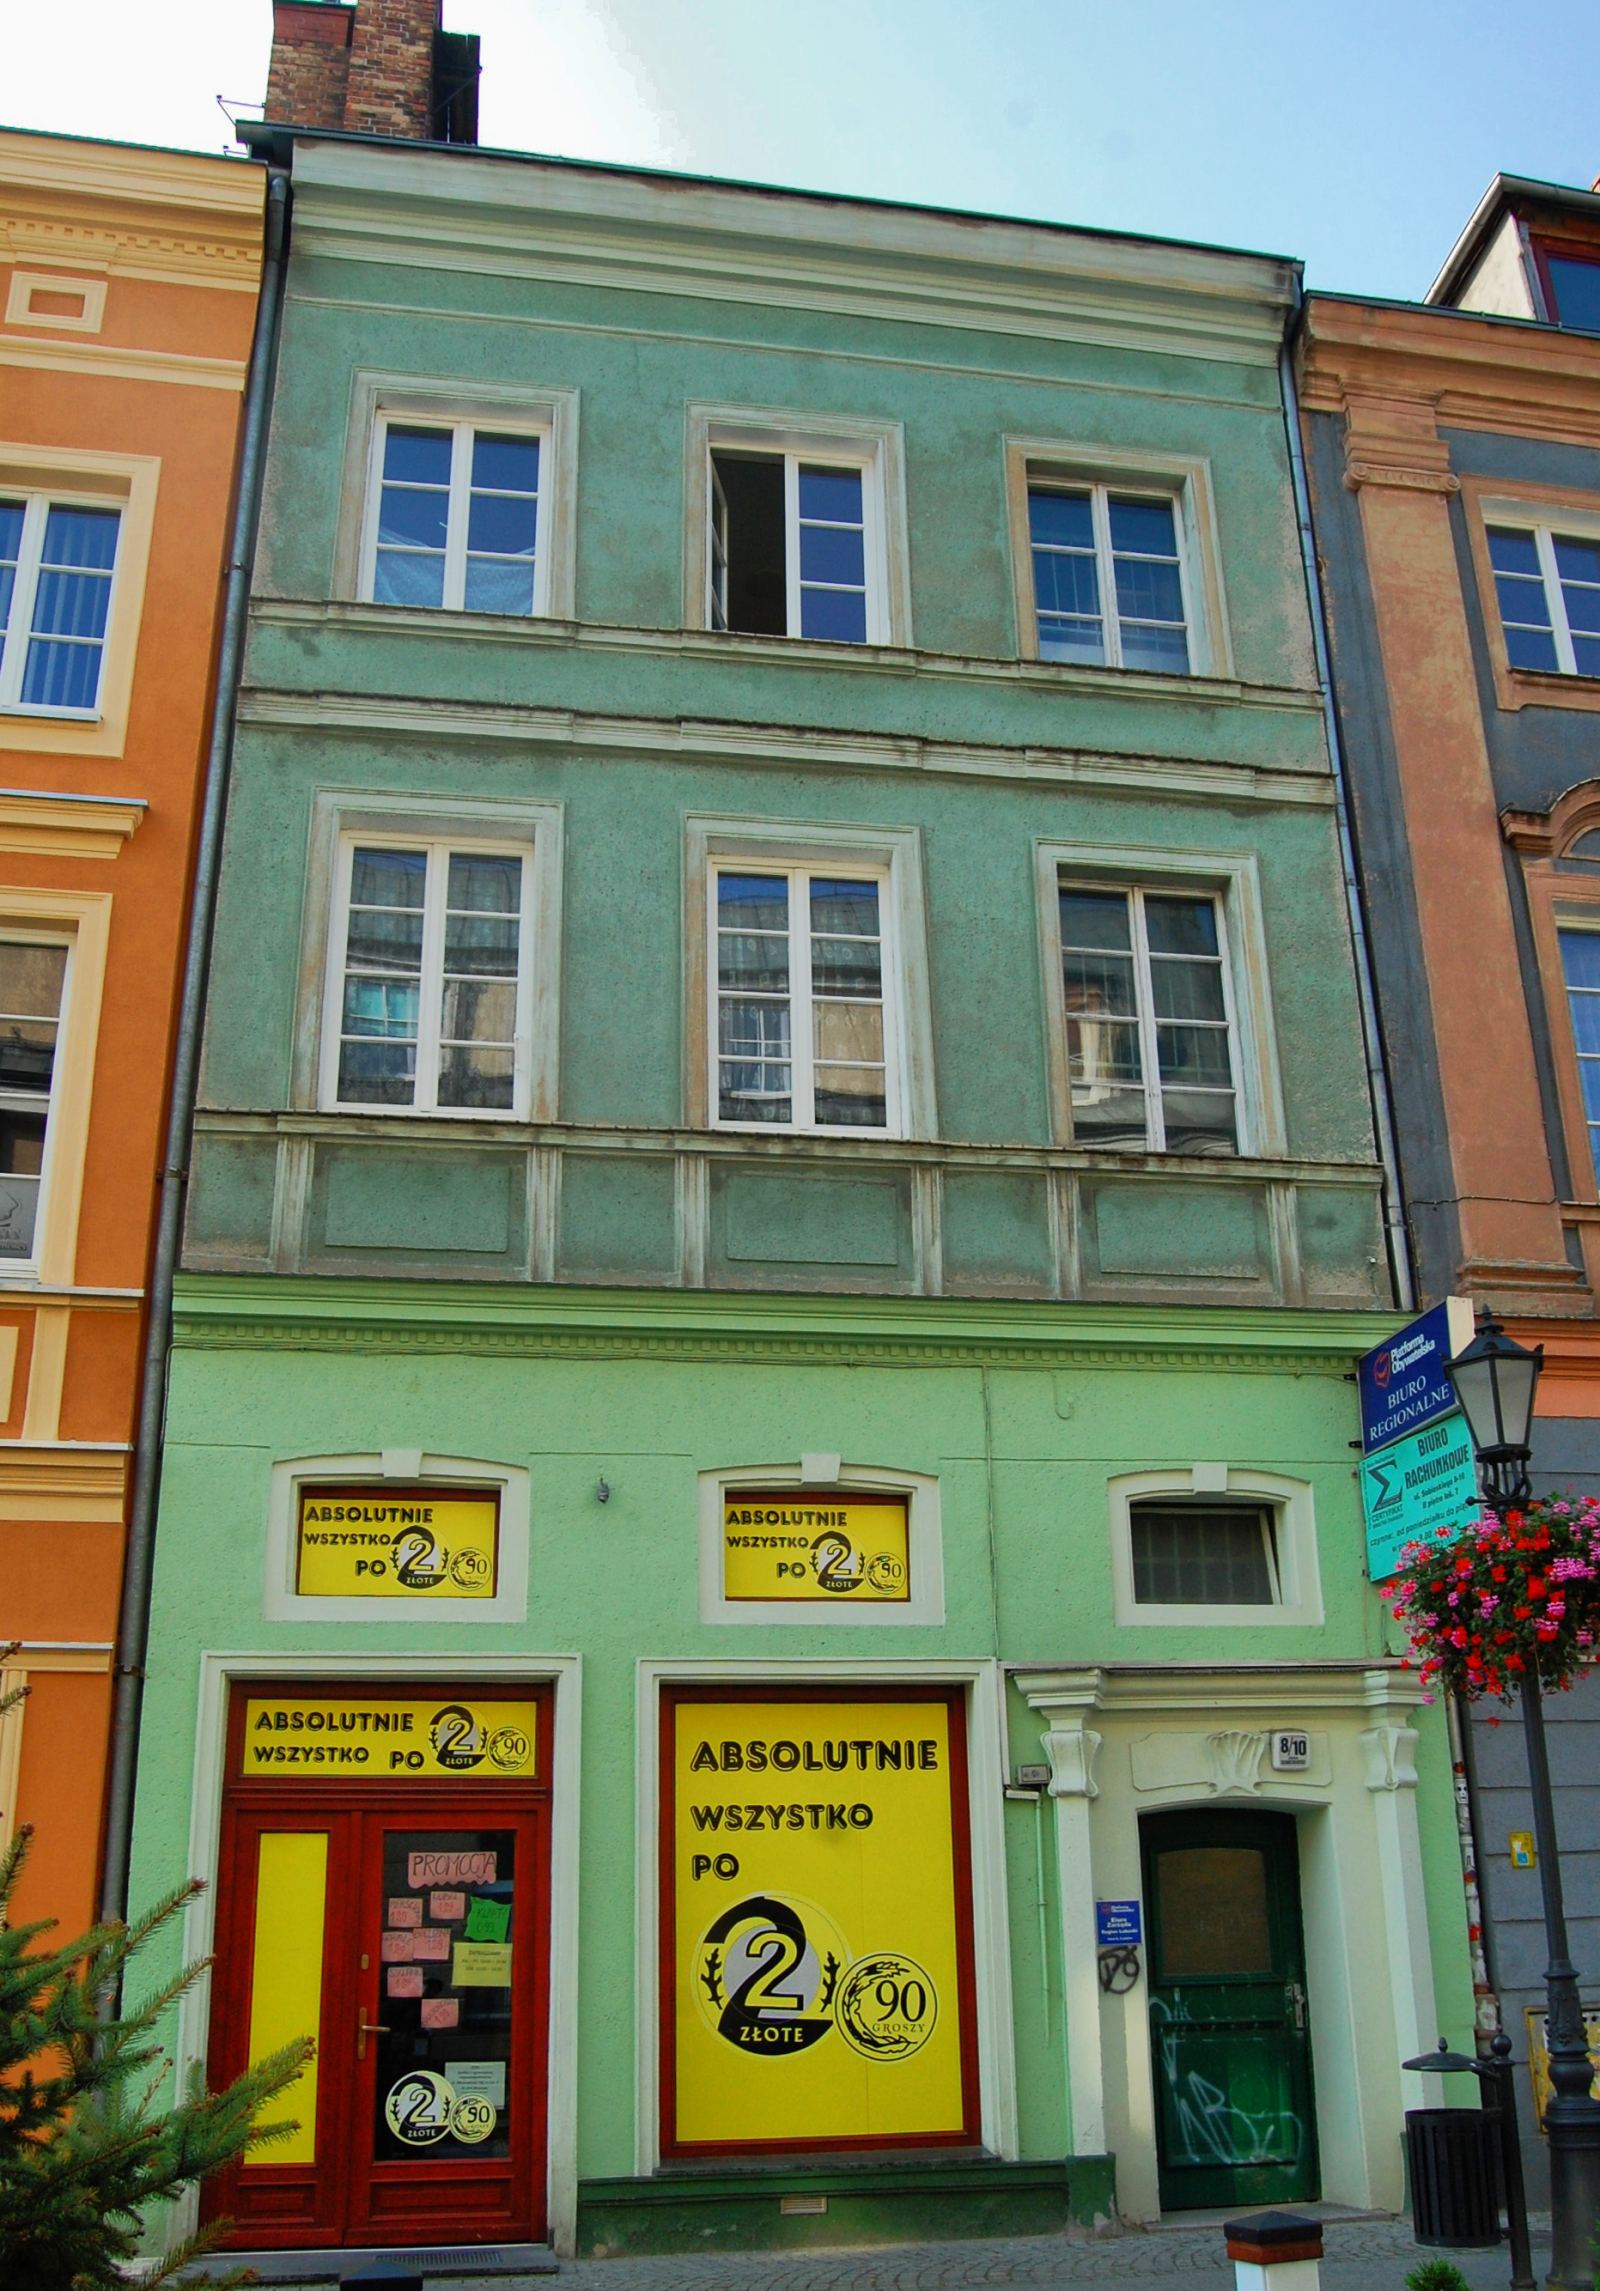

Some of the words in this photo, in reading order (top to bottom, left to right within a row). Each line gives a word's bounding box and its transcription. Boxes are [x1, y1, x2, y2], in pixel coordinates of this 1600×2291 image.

[1390, 1333, 1425, 1362] Platforma
[1392, 1340, 1436, 1374] Obywatelska
[1387, 1375, 1427, 1409] BIURO
[1369, 1383, 1450, 1441] REGIONALNE
[1417, 1427, 1448, 1457] BIURO
[1404, 1444, 1470, 1489] RACHUNKOWE
[304, 1506, 433, 1523] ABSOLUTNIE
[726, 1510, 848, 1526] ABSOLUTNIE
[304, 1533, 391, 1546] WSZYSTKO
[726, 1536, 809, 1549] WSZYSTKO
[355, 1559, 387, 1577] PO
[465, 1558, 488, 1575] 90
[776, 1562, 807, 1579] PO
[880, 1562, 902, 1578] 90
[406, 1576, 435, 1585] ZŁOTE
[826, 1580, 853, 1588] ZŁOTE
[254, 1711, 414, 1731] ABSOLUTNIE
[503, 1737, 526, 1755] 90
[1280, 1736, 1307, 1756] 8/10
[253, 1746, 370, 1763] WSZYSTKO
[389, 1750, 425, 1770] PO
[445, 1756, 474, 1765] ZŁOTE
[690, 1739, 938, 1772] ABSOLUTNIE
[690, 1803, 874, 1831] WSZYSTKO
[412, 1852, 498, 1880] PROMOCJA
[691, 1852, 740, 1882] PO
[875, 1979, 927, 2023] 90
[739, 2025, 804, 2043] ZŁOTE
[872, 2022, 926, 2034] GROSZY
[409, 2087, 436, 2123] 2
[467, 2105, 490, 2123] 90
[407, 2129, 436, 2138] ZŁOTE
